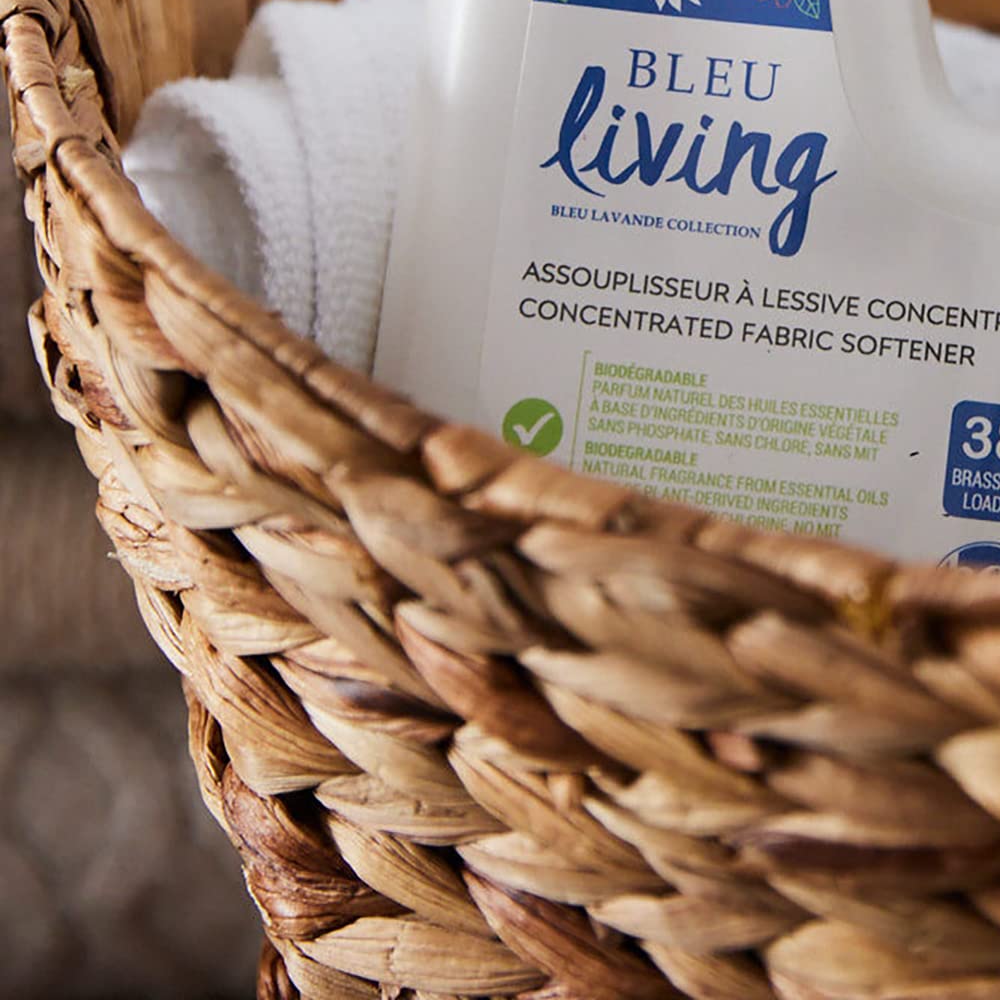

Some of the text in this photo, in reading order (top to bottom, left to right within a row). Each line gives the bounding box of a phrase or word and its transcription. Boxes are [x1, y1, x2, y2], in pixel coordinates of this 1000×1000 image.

[627, 48, 782, 101] BLEU
[539, 66, 838, 257] living
[550, 204, 761, 239] BLEU LAVANDE COLLECTION
[522, 261, 730, 304] ASSOUPLISSEUR
[735, 279, 754, 306] À
[762, 287, 860, 317] LESSIVE
[518, 298, 976, 366] CONCENTRATED FABRIC SOFTENER
[594, 361, 708, 388] BIODÉGRADABLE
[592, 379, 899, 427] PARFUM NATUREL DES HUILES ESSENTIELLES
[602, 399, 637, 417] BASE
[747, 415, 815, 438] D'ORIGINE
[819, 421, 888, 445] VÉGÉTALE
[584, 440, 698, 467] BIODEGRADABLE
[587, 416, 625, 434] SANS
[714, 430, 753, 449] SANS
[814, 441, 851, 459] SANS
[853, 446, 880, 462] MIT
[582, 458, 889, 507] NATURAL FRAGRANCE FROM ESSENTIAL OILS
[756, 497, 849, 521] INGREDIENTS
